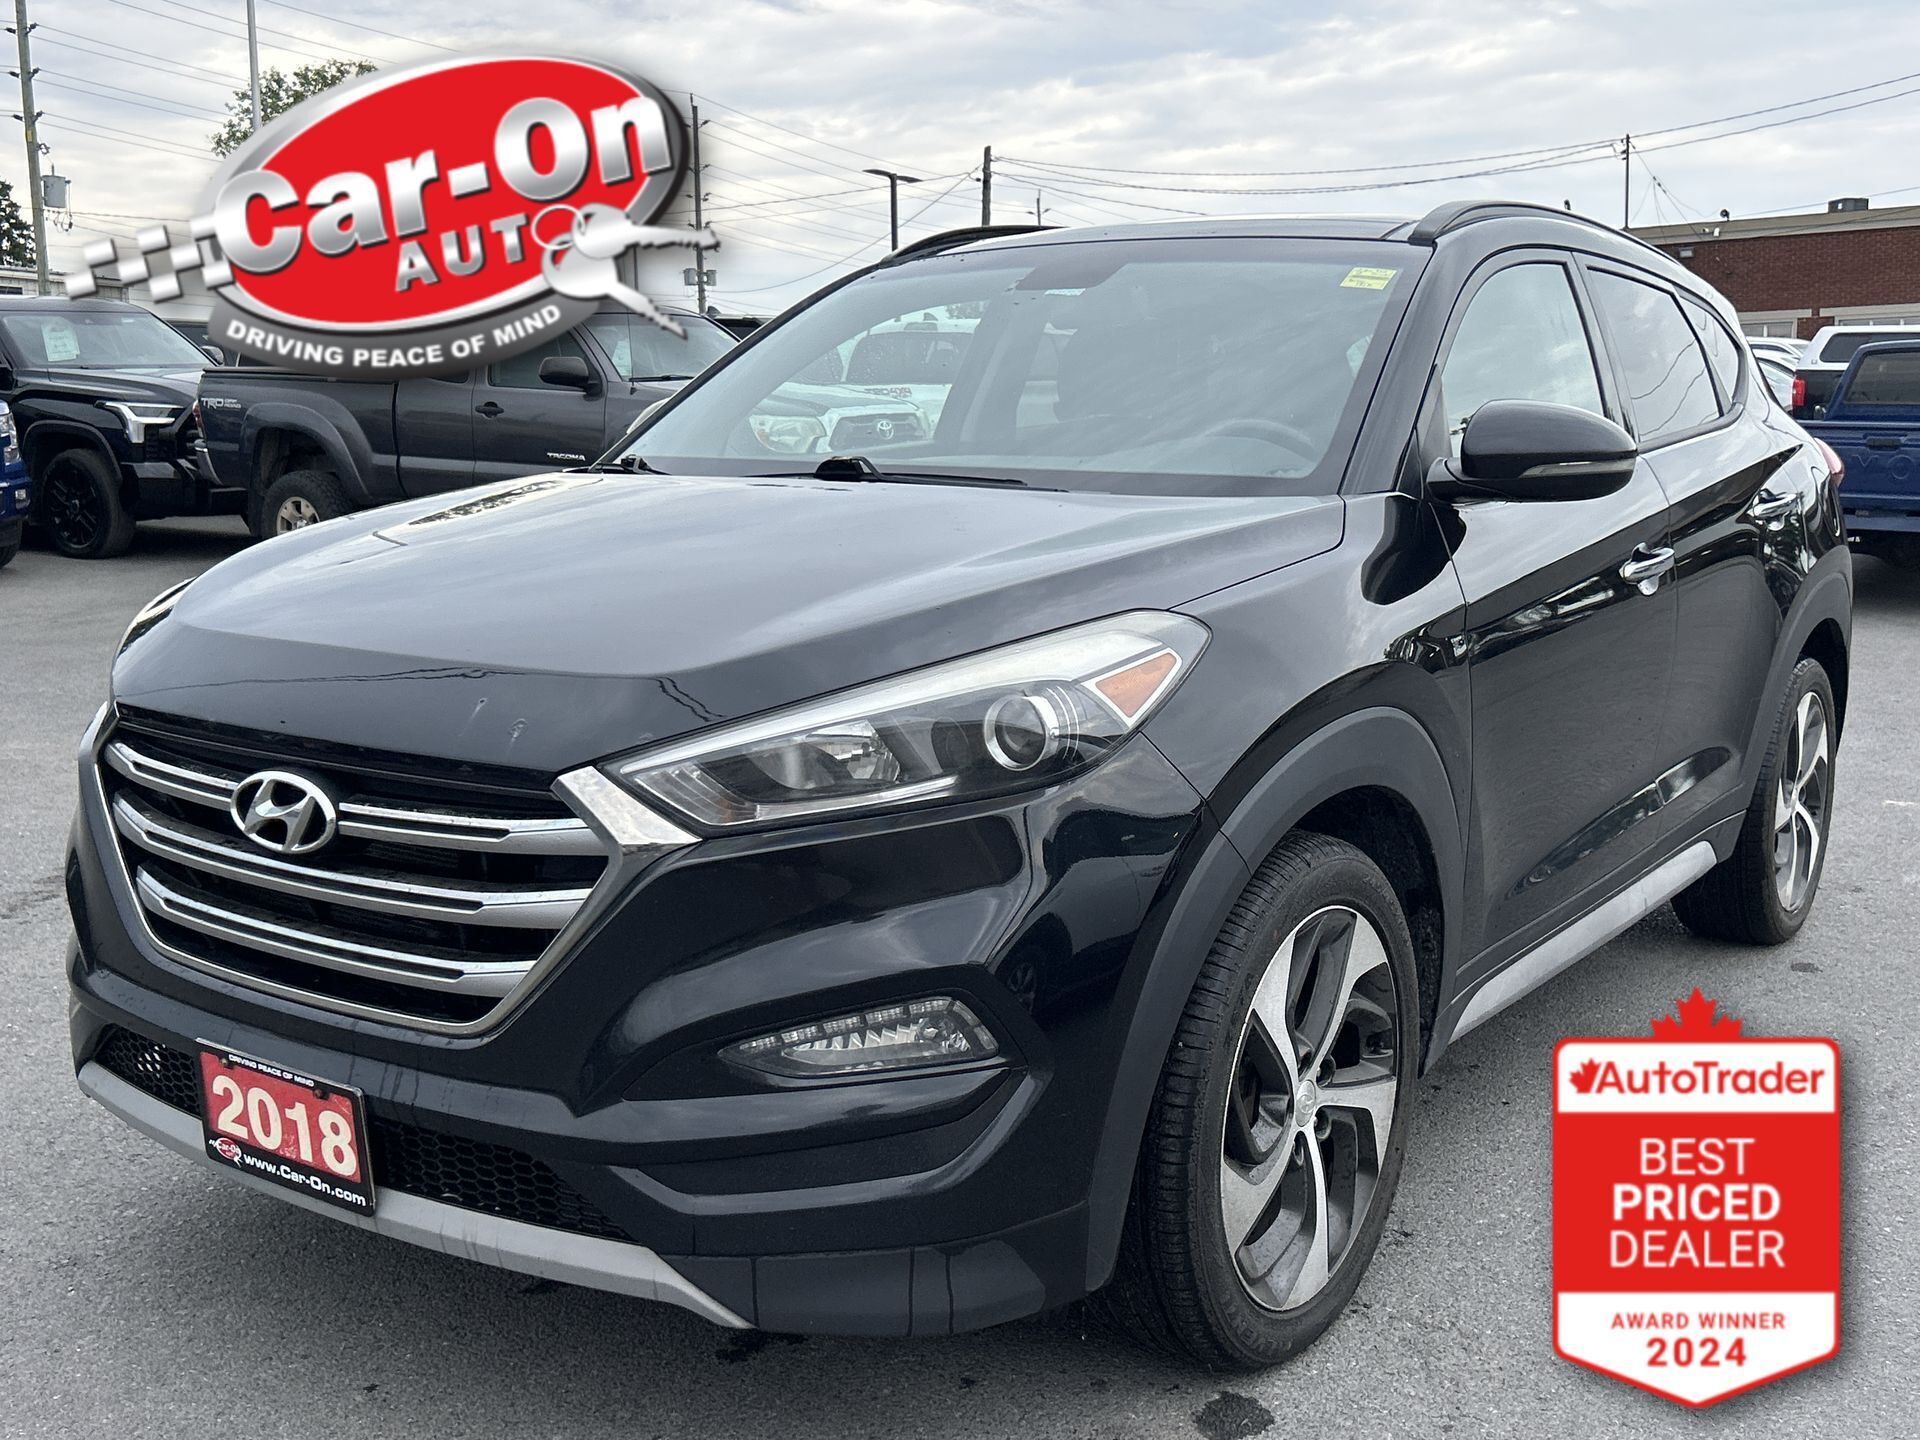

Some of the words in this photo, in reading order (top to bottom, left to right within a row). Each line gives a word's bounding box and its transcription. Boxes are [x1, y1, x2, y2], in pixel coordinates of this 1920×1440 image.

[201, 397, 223, 409] TRD
[547, 452, 586, 461] TACOMA
[228, 1054, 257, 1069] DRIVING
[258, 1064, 282, 1077] PEACE
[282, 1071, 293, 1080] OF
[294, 1075, 315, 1087] MIND
[212, 1075, 357, 1177] 2018
[243, 1153, 367, 1207] www.Car-On.com
